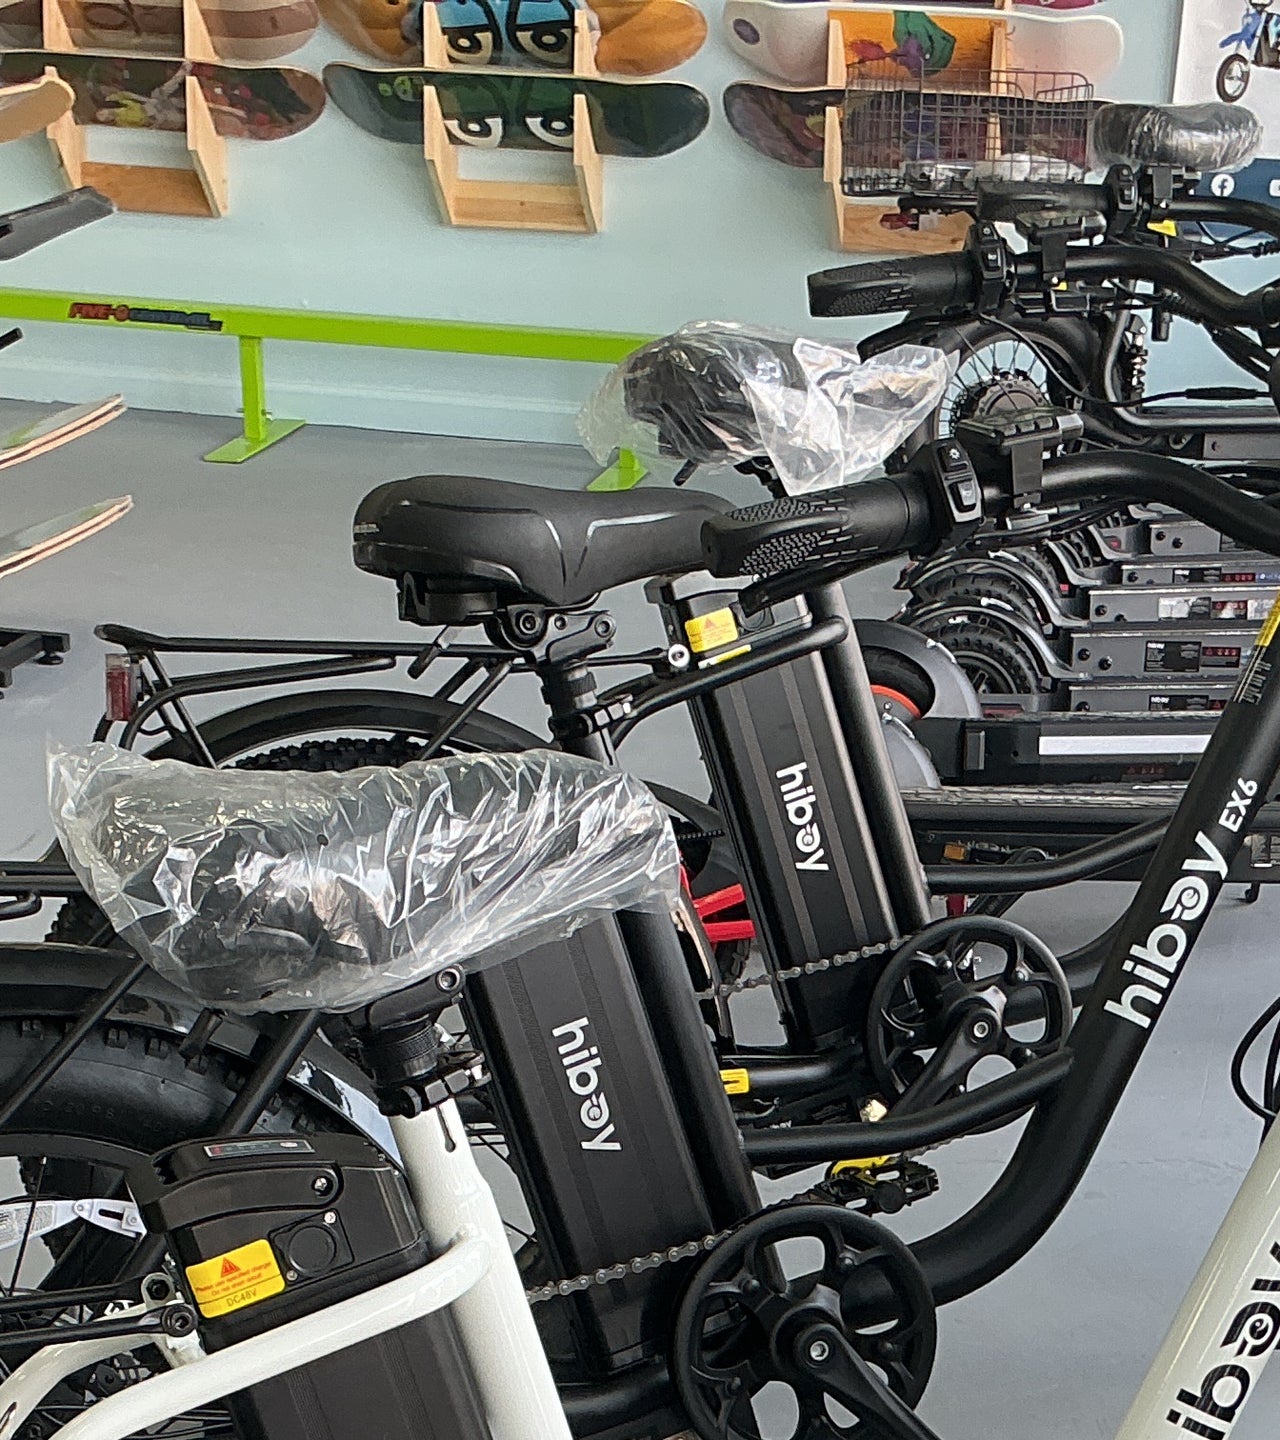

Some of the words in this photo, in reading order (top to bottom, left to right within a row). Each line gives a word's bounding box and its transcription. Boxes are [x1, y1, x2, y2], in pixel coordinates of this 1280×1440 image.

[776, 761, 829, 871] hiboy
[1103, 830, 1229, 1029] hiboy
[1218, 777, 1259, 833] EX6
[552, 1016, 622, 1152] hiboy
